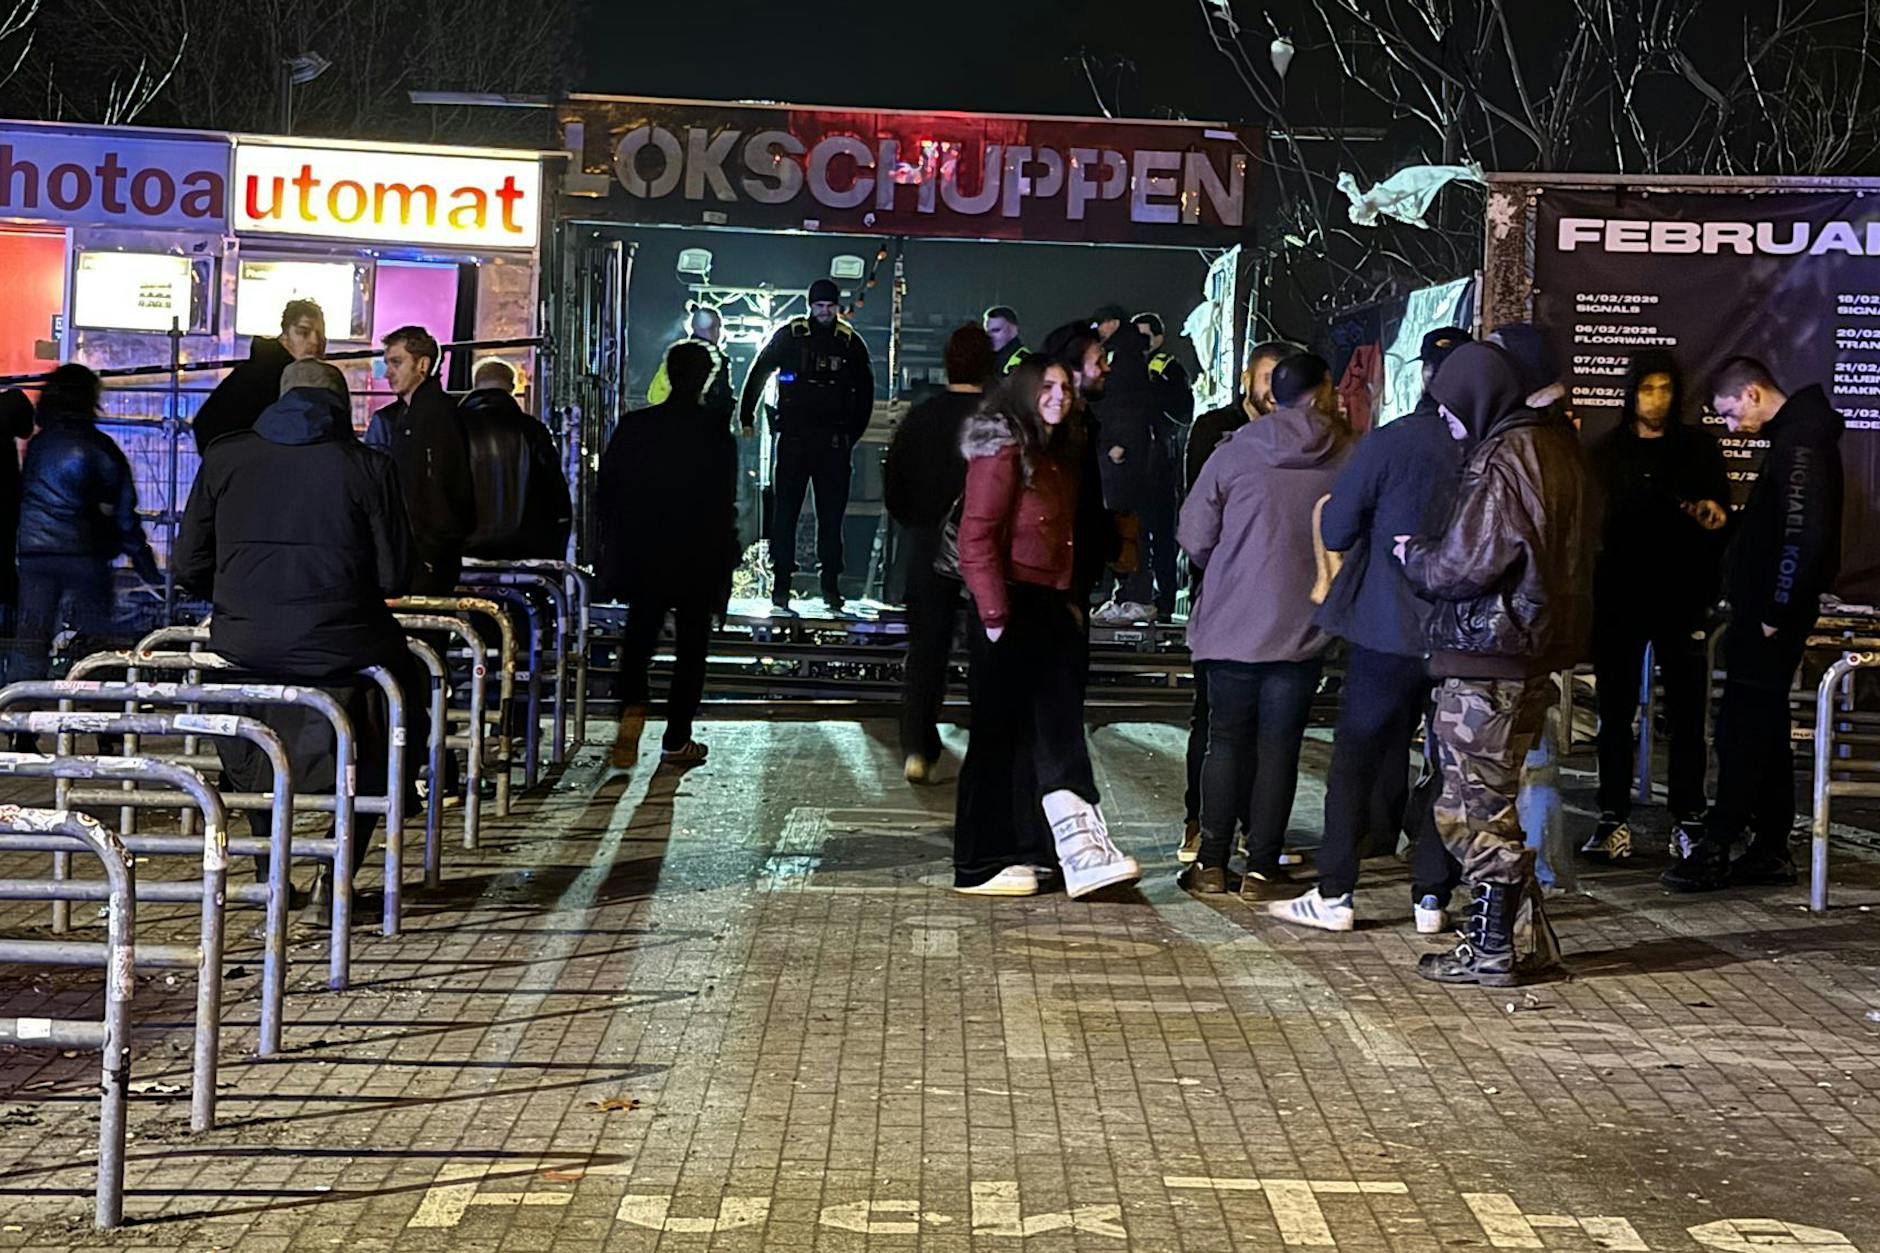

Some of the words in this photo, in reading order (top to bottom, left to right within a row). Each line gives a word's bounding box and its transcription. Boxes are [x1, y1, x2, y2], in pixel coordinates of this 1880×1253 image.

[560, 122, 1246, 226] LOKSCHUPPEN
[1576, 294, 1659, 303] 04/02/2026
[1576, 304, 1640, 313] SIGNALS
[1837, 306, 1880, 315] SIGN
[1575, 325, 1657, 334] 06/02/2026
[1785, 446, 1811, 537] MICHAEL
[1774, 545, 1800, 605] KORS
